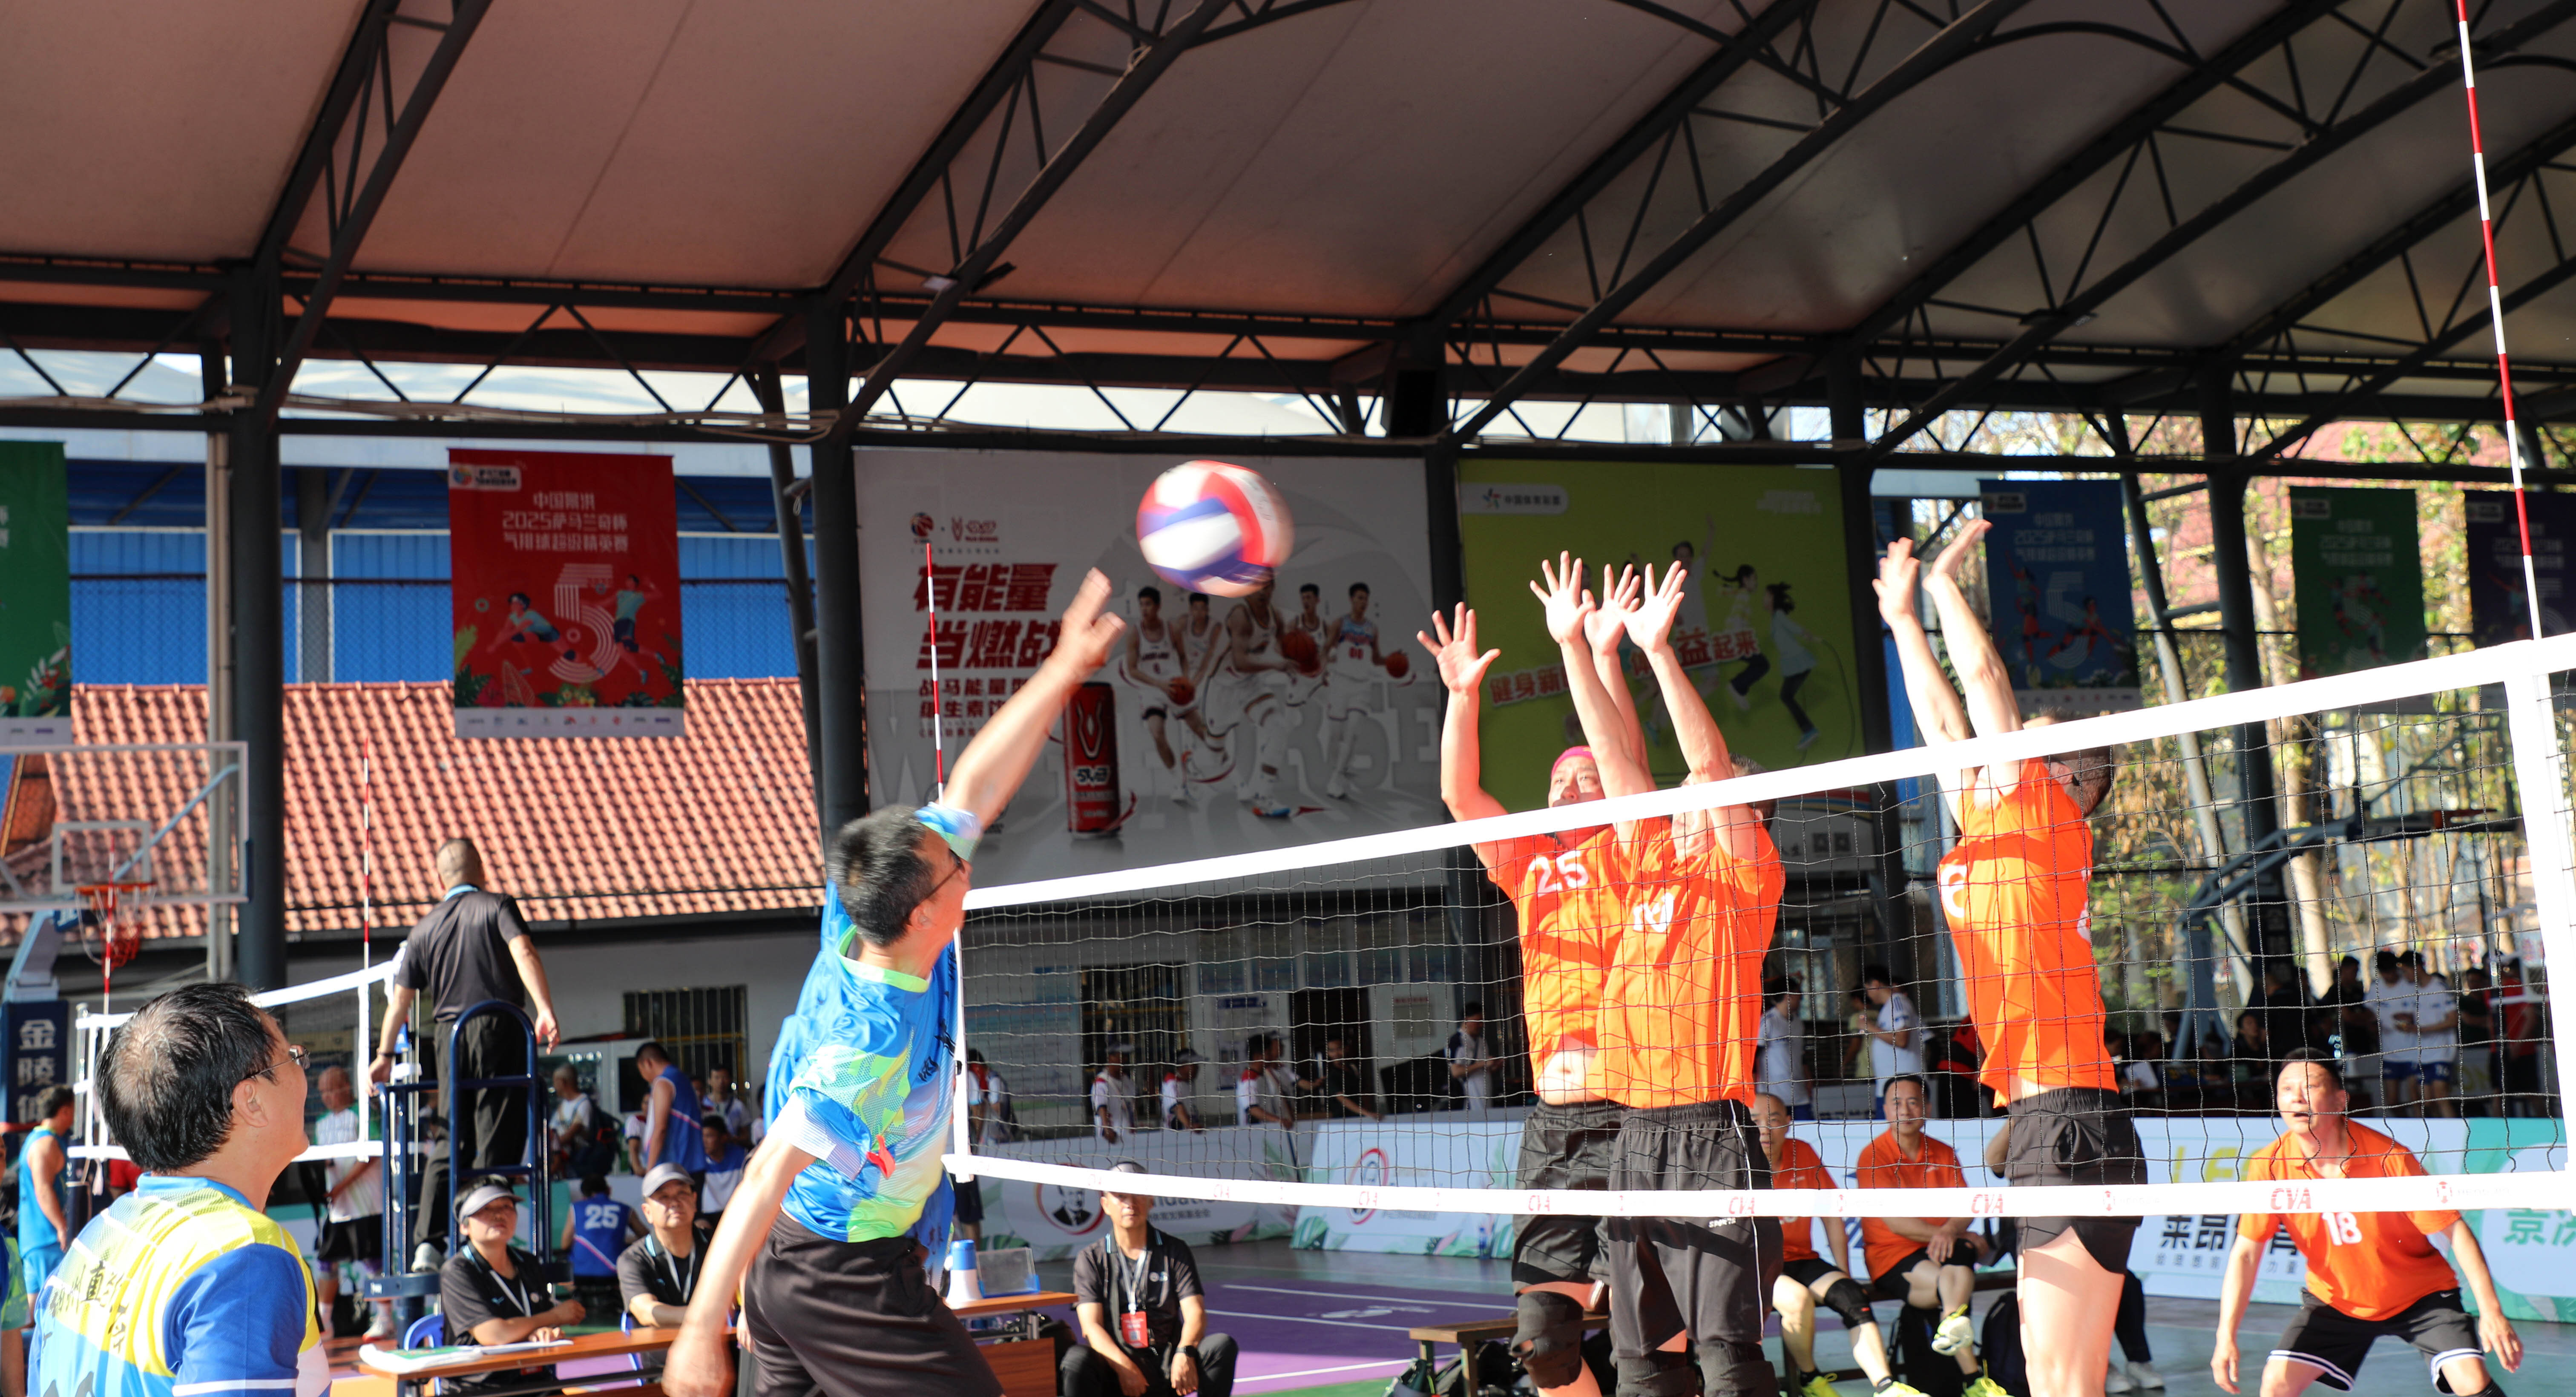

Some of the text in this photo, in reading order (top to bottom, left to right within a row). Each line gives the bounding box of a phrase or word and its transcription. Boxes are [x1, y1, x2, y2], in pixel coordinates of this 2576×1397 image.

[502, 511, 628, 531] 2025萨马兰奇杯
[913, 563, 1058, 612] 有能量
[1528, 849, 1589, 897] 25
[1528, 1195, 1551, 1211] CVA
[1728, 1196, 1756, 1215] CVA
[1971, 1193, 2004, 1214] CVA
[2270, 1187, 2312, 1210] CVA
[584, 1205, 620, 1230] 25
[1708, 1217, 1736, 1228] SPORTS
[2321, 1211, 2363, 1246] 18
